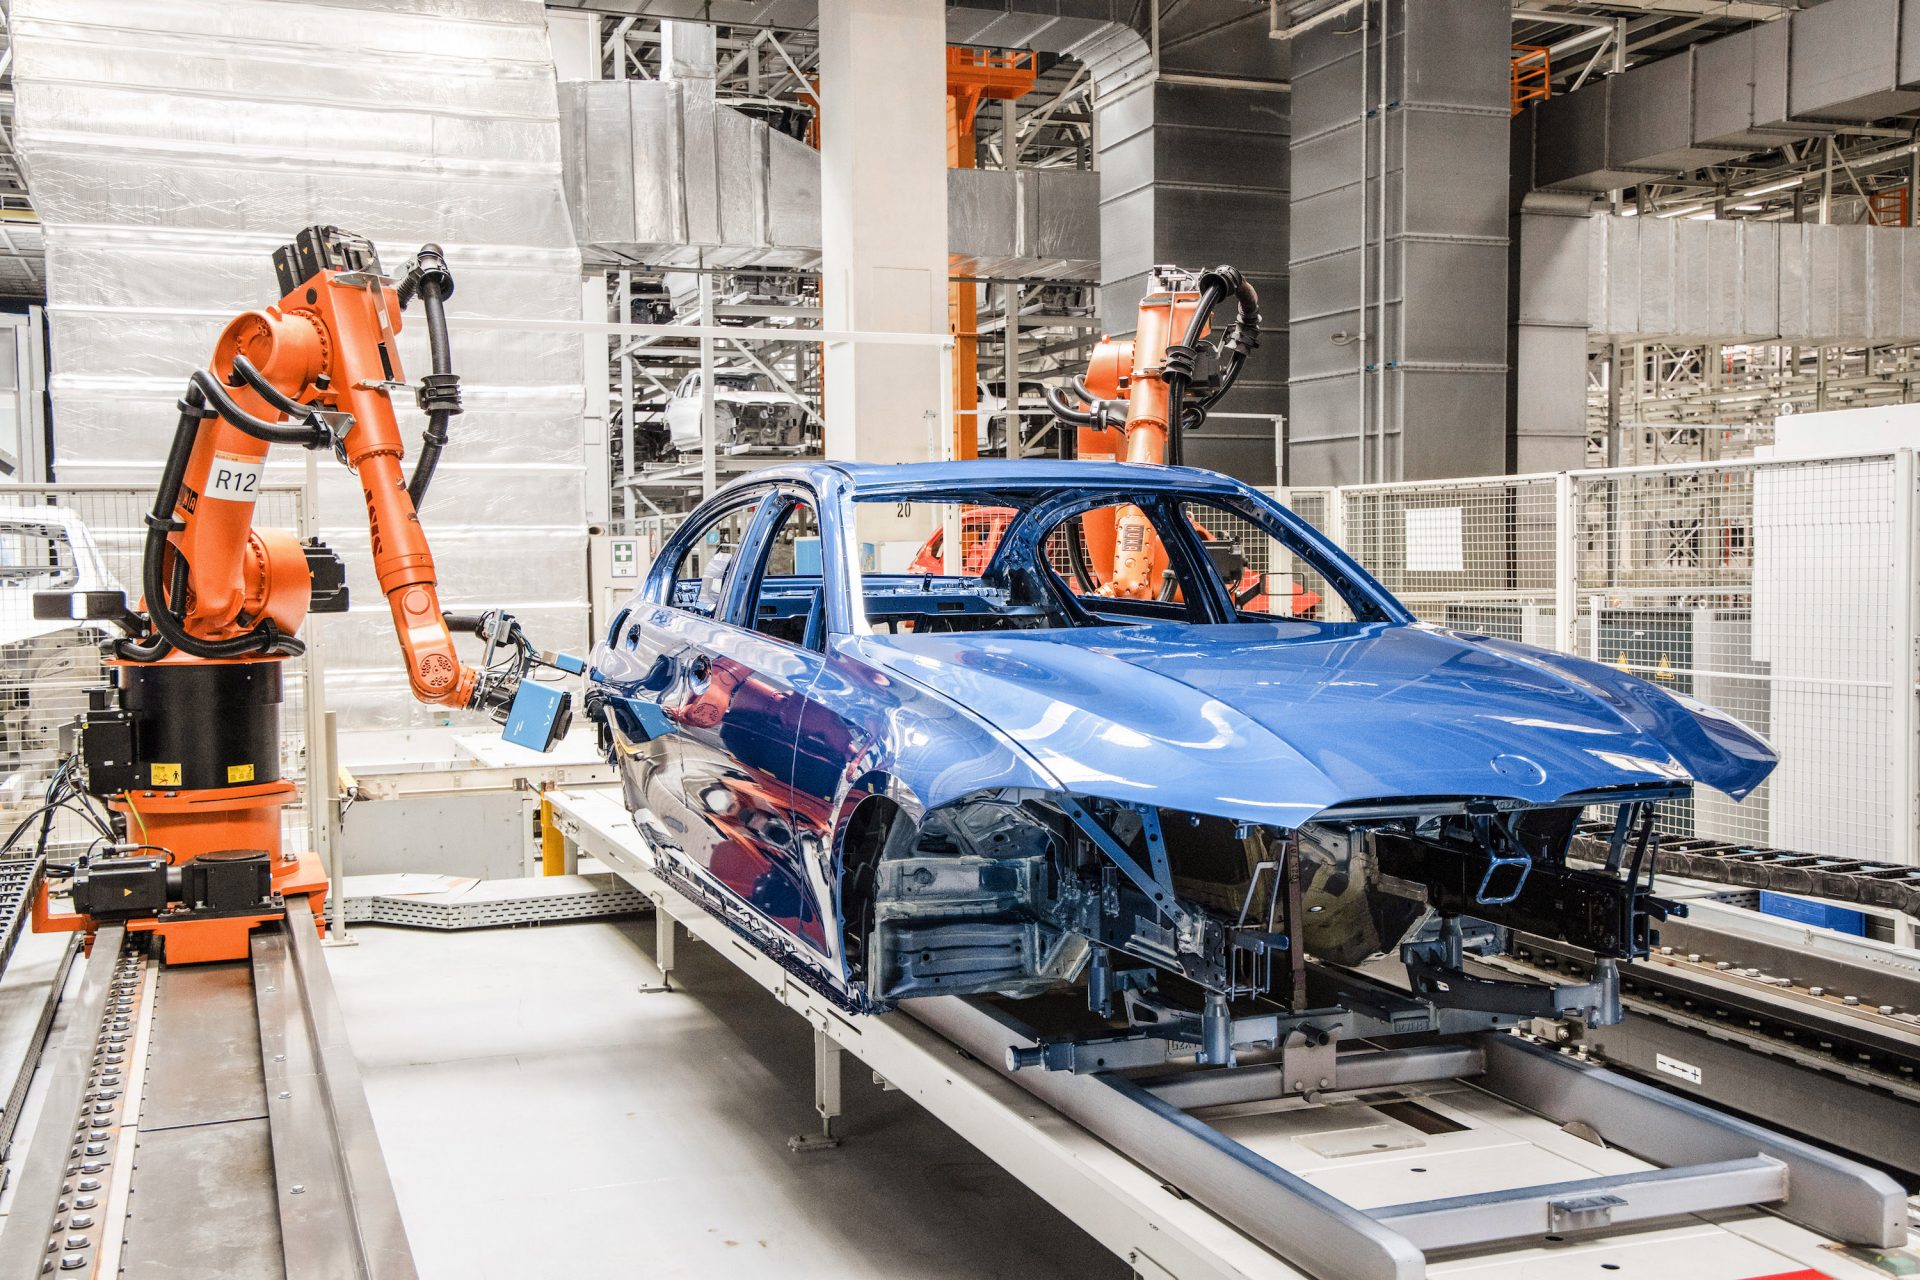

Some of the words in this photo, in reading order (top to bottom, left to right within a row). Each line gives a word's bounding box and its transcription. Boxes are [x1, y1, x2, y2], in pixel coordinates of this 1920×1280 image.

[215, 469, 256, 492] R12
[897, 502, 911, 518] 20
[1125, 526, 1141, 551] KUKA
